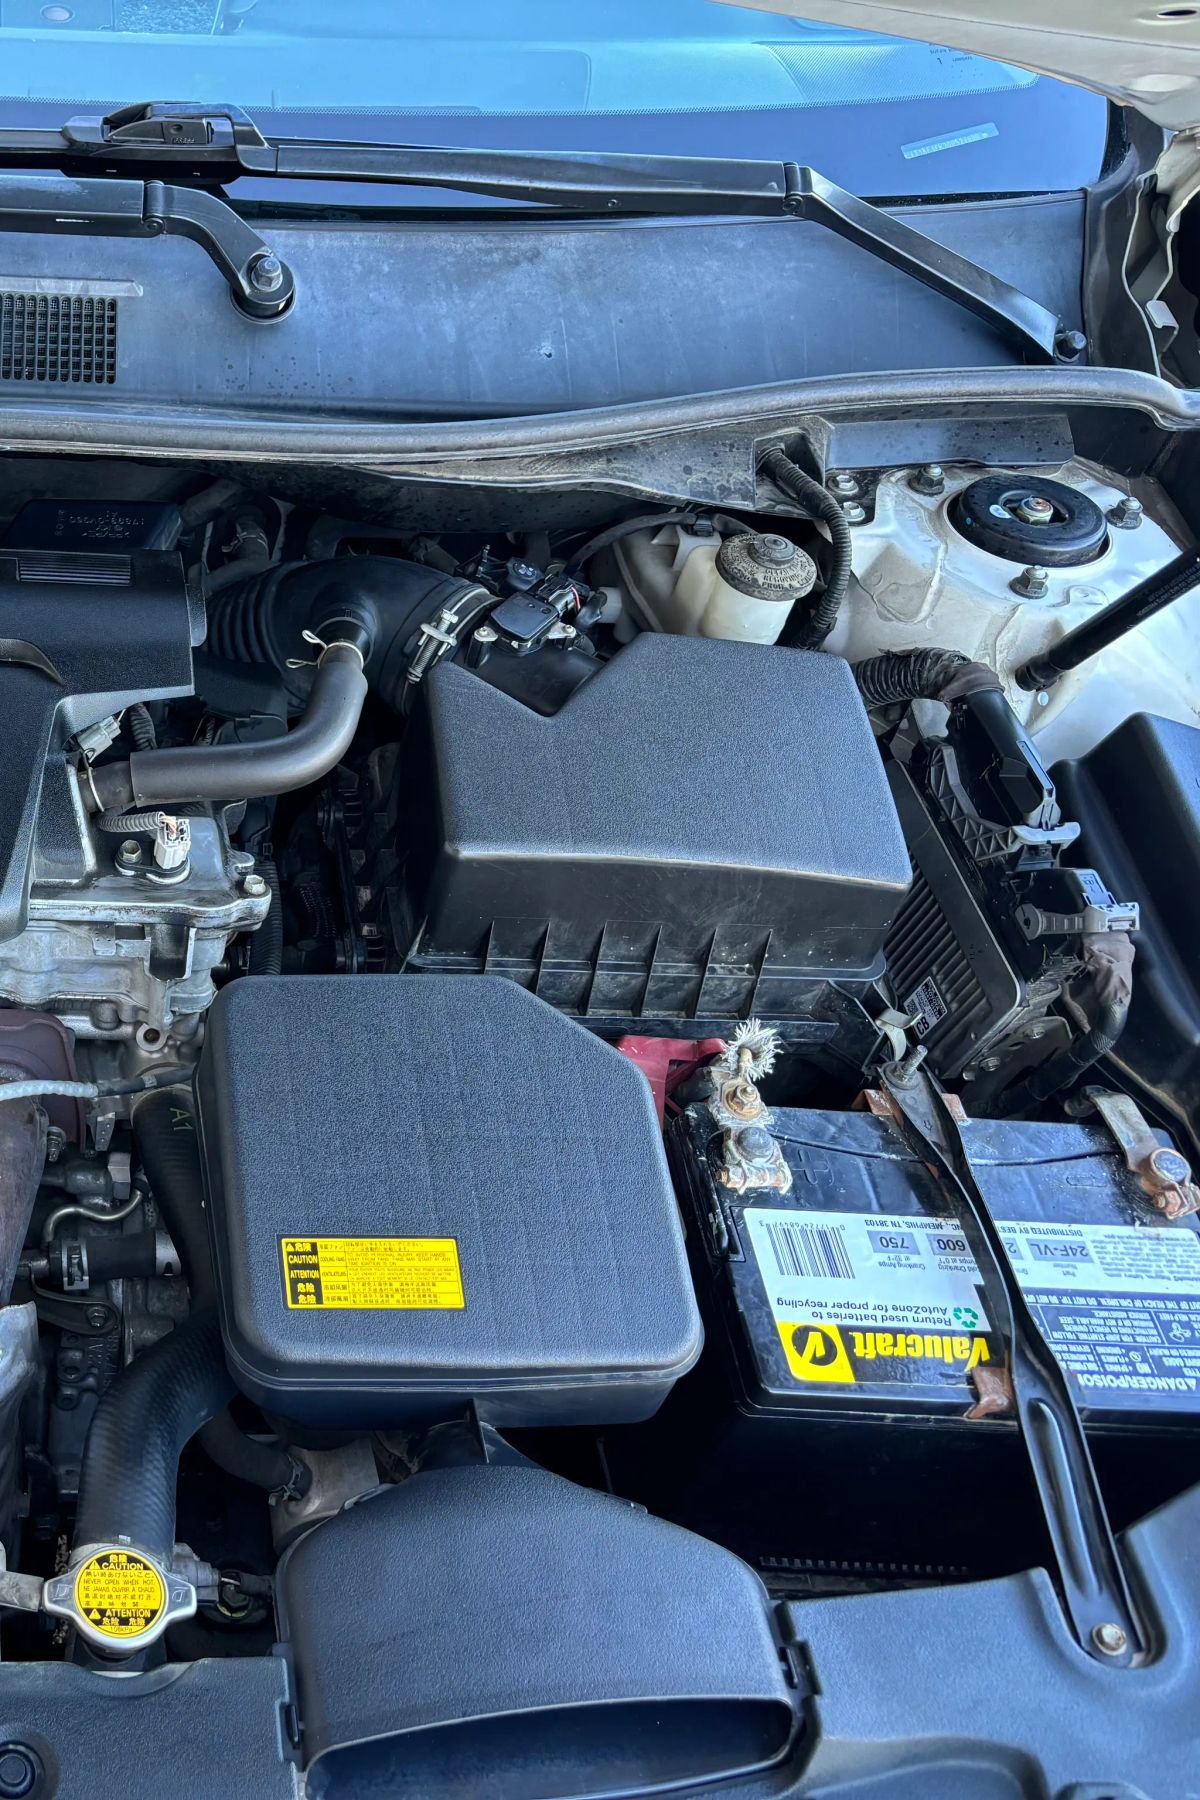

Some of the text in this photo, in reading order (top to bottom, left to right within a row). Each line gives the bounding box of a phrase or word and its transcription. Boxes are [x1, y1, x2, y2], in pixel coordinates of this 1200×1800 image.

[916, 1017, 930, 1035] CB
[169, 1107, 193, 1131] A1
[864, 1219, 889, 1228] 38103
[890, 1220, 901, 1228] TN
[902, 1220, 944, 1230] MEMPHIS,
[1019, 1226, 1029, 1234] BY
[1030, 1227, 1083, 1238] DISTRIBUTED
[879, 1236, 966, 1252] 600 750
[1029, 1243, 1089, 1257] 24F-VL
[288, 1255, 318, 1264] CAUTION
[878, 1261, 926, 1270] Cranking Amps
[938, 1263, 967, 1273] Cranking
[290, 1269, 320, 1279] ATTENTION
[1062, 1270, 1076, 1278] Part
[776, 1297, 948, 1315] AutoZone for proper recycling
[811, 1311, 952, 1327] Return used batteries to
[853, 1332, 991, 1373] Valucraft
[1135, 1362, 1152, 1374] NO
[105, 1609, 151, 1618] ATTENTION
